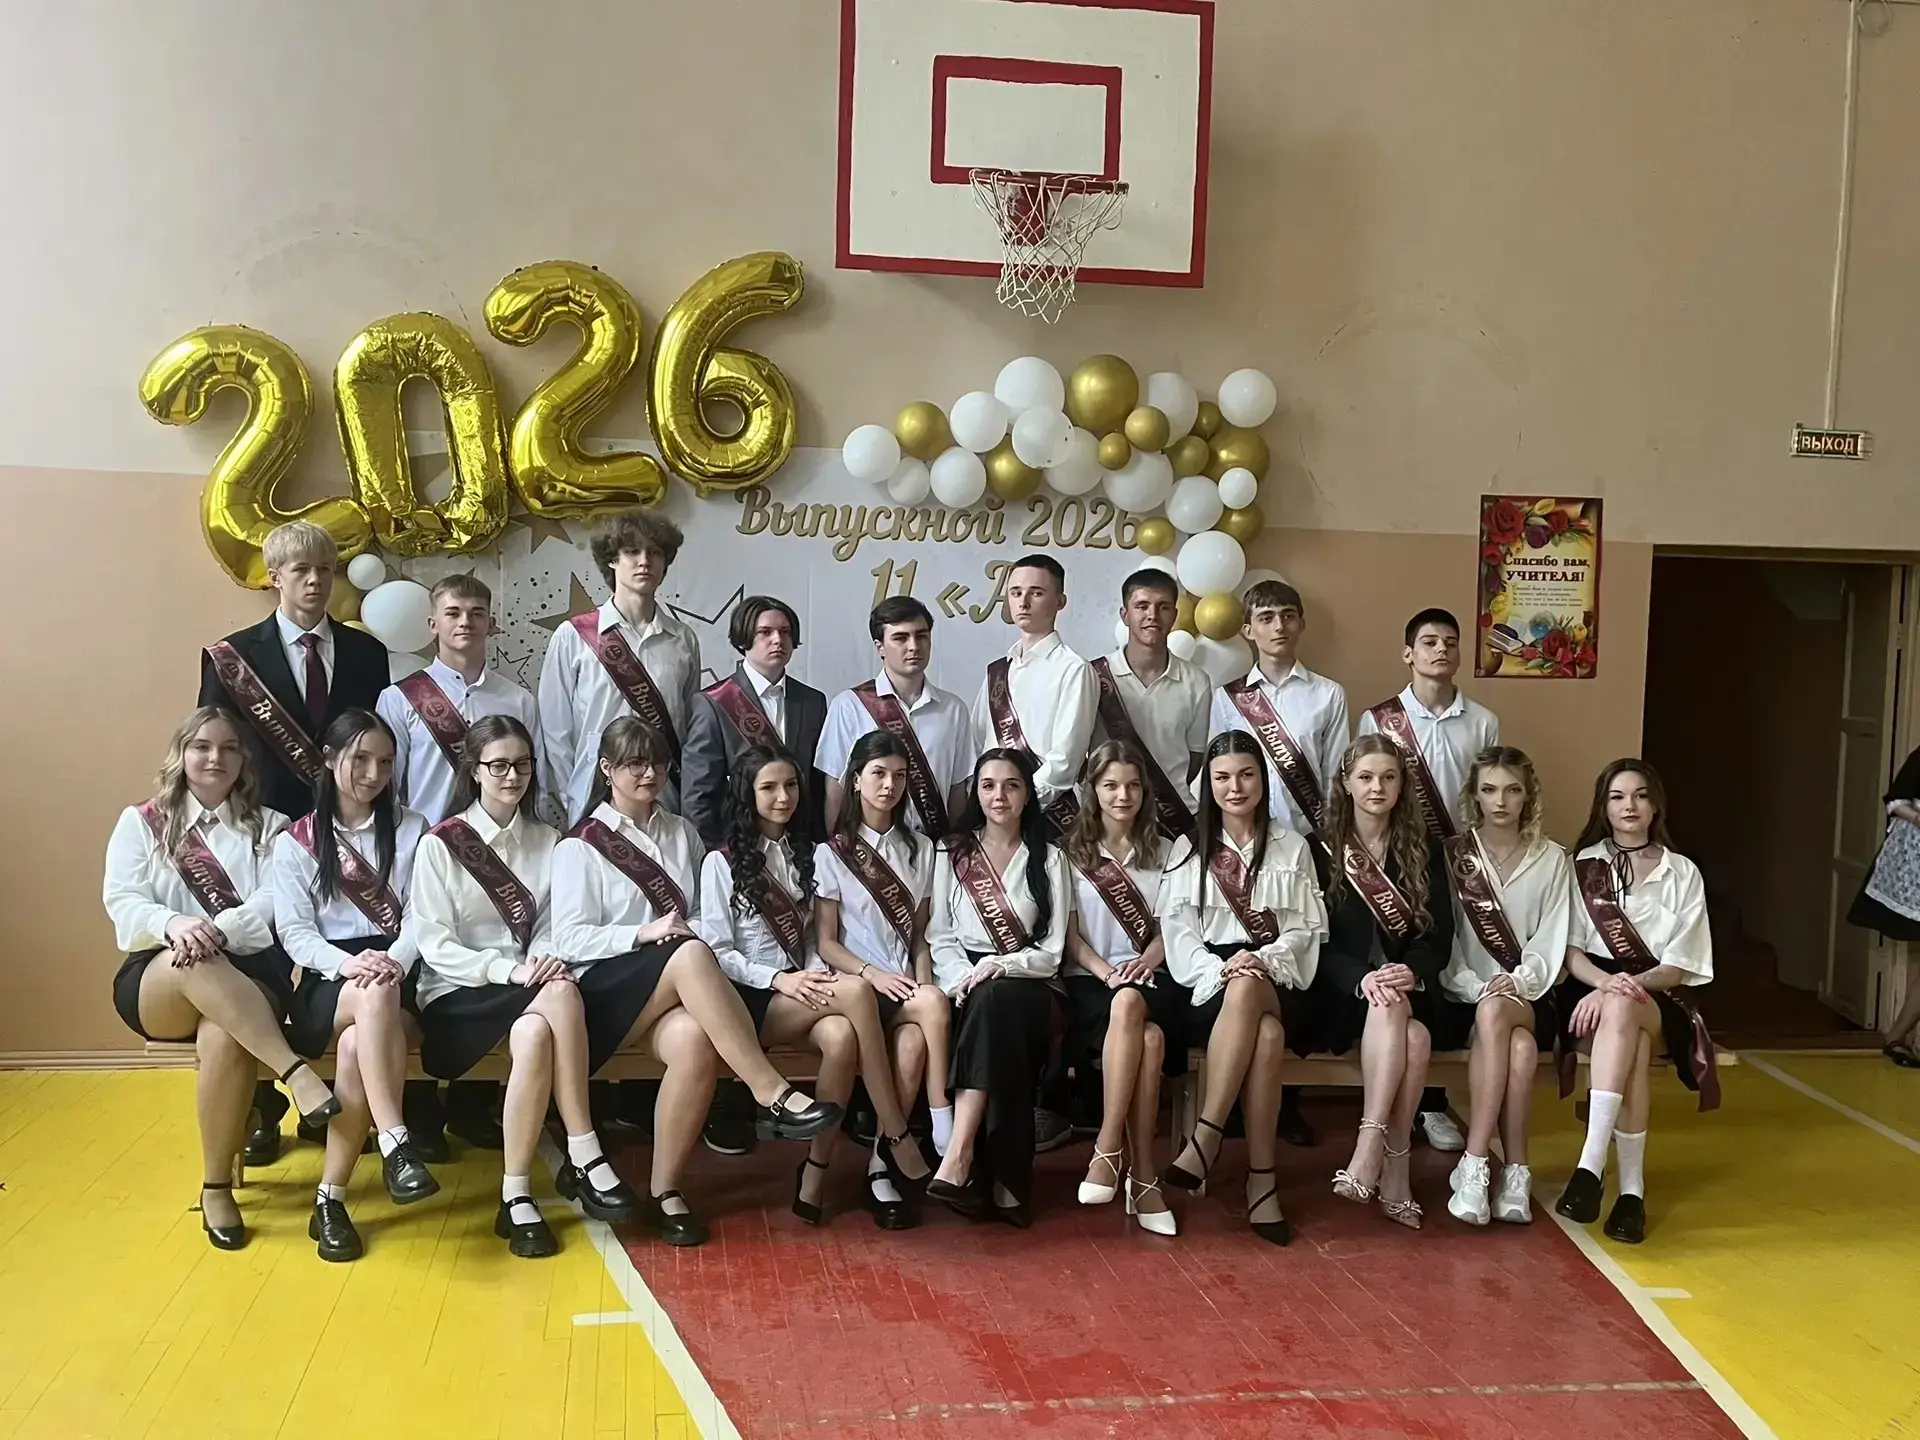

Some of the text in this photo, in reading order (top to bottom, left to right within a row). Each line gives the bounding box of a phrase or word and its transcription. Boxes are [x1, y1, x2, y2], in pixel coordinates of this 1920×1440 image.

[139, 251, 804, 590] 2026
[1801, 435, 1854, 454] ВЫХОД
[734, 485, 1141, 562] Выпускной 2026
[1503, 555, 1590, 567] Спасибо вам,
[1505, 570, 1585, 582] УЧИТЕЛЯ!
